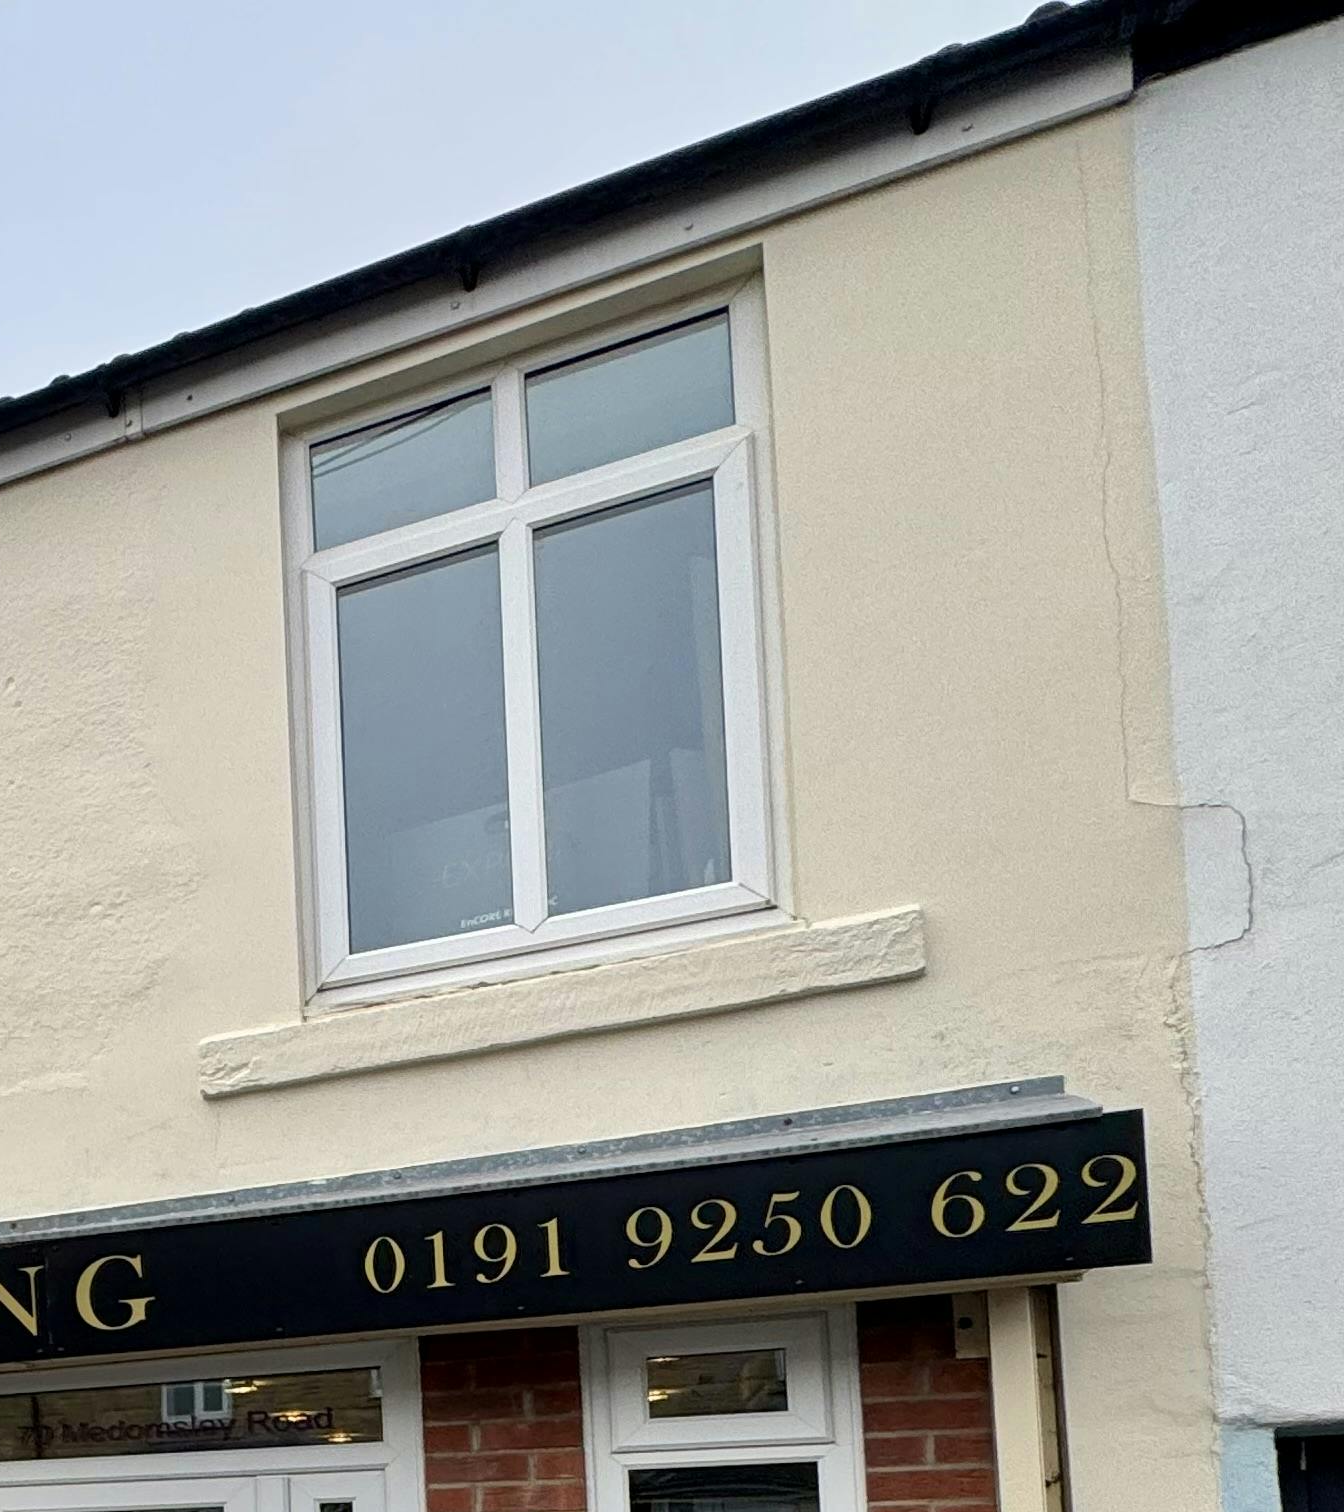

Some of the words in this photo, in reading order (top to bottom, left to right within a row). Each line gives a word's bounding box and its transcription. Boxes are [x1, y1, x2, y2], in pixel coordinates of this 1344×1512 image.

[364, 1217, 571, 1294] 0191
[625, 1184, 874, 1270] 9250
[930, 1154, 1141, 1239] 622
[61, 1411, 236, 1442] Medomsley
[247, 1407, 335, 1434] Road
